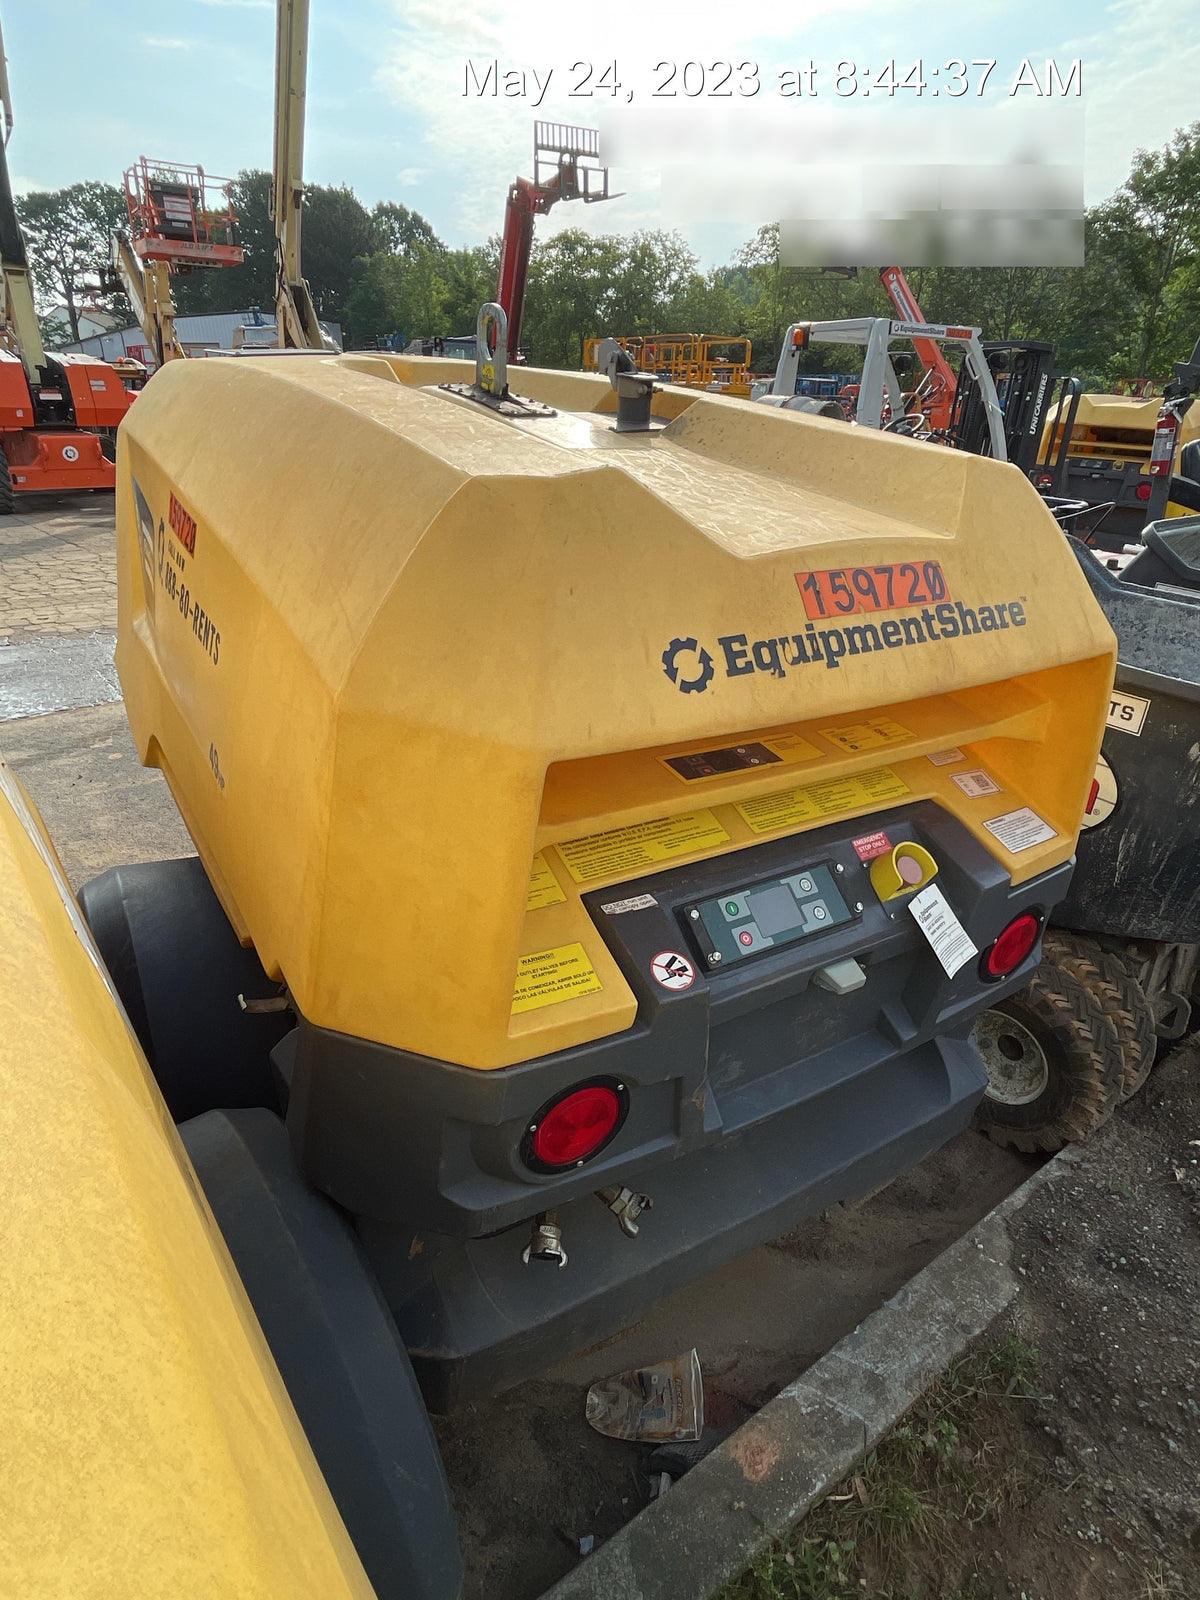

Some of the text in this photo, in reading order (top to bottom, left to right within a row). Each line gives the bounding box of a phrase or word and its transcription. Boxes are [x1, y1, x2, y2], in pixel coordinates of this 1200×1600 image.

[900, 324, 945, 335] EquipmentShare
[802, 562, 946, 615] 159720
[717, 600, 1027, 678] EquipmentShare
[853, 831, 883, 847] EMERGENCY
[858, 839, 886, 853] STOP ONLY
[519, 968, 539, 977] OUTLET
[540, 963, 559, 972] VALVES
[559, 958, 578, 967] BEFORE
